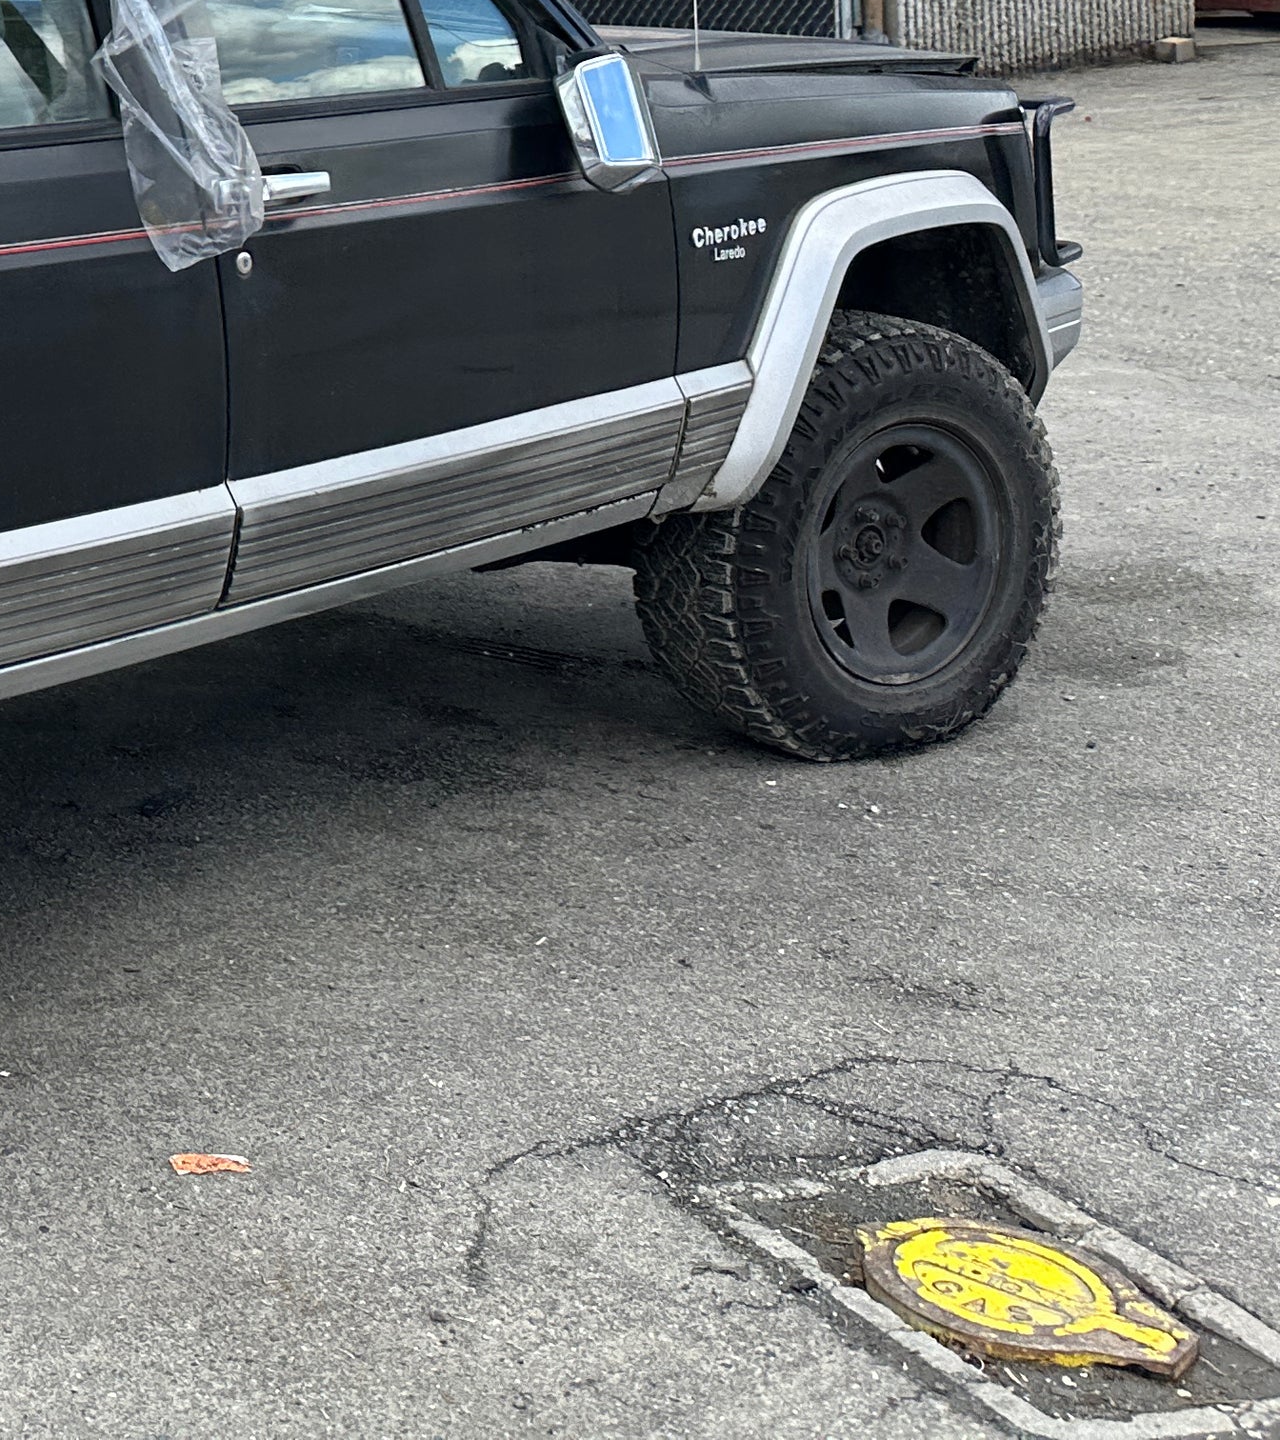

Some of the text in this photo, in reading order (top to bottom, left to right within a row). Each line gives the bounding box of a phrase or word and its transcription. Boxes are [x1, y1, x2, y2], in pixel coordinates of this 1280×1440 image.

[692, 217, 767, 248] Cherokee
[714, 245, 746, 261] Laredo
[931, 1279, 1033, 1322] GAS
